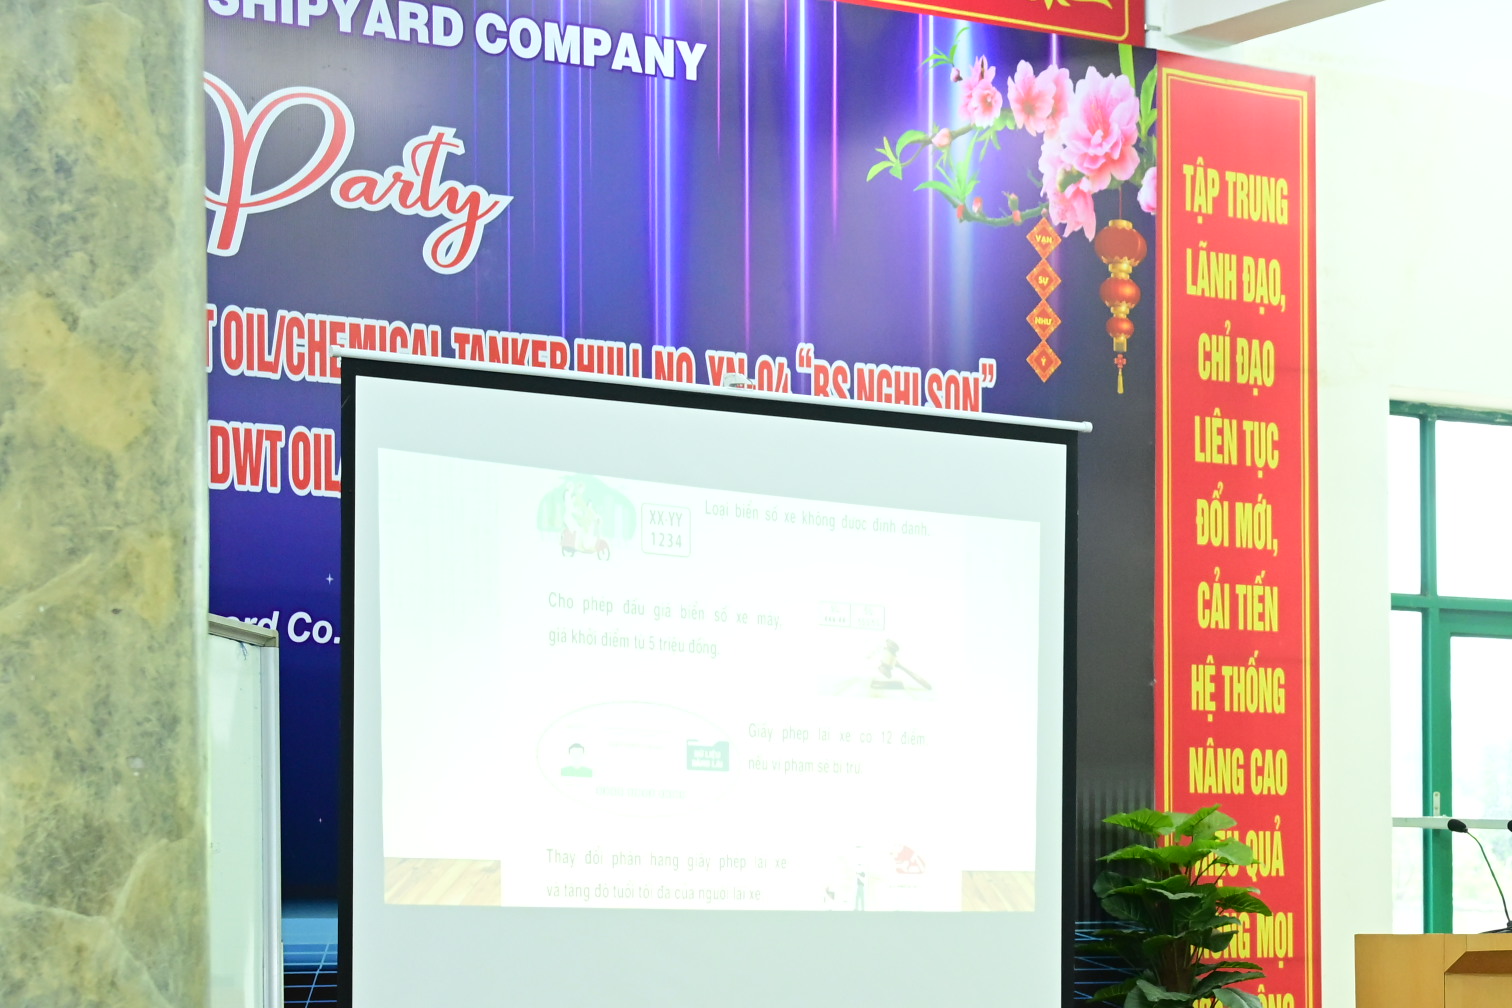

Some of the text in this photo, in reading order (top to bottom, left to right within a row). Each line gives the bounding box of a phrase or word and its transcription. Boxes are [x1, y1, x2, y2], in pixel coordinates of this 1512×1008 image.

[475, 11, 708, 81] COMPANY
[203, 72, 513, 274] Party
[1183, 156, 1288, 225] TẬP TRUNG
[1186, 241, 1286, 315] LÃNH ĐẠO,
[1198, 320, 1275, 396] CHỈ ĐẠO
[289, 426, 341, 498] OIL
[1194, 407, 1279, 478] LIÊN TỤC
[651, 531, 682, 548] 1234
[1196, 481, 1278, 556] ĐỔI MỚI,
[286, 611, 341, 645] Co.
[548, 591, 574, 609] Cho
[1197, 566, 1279, 632] CẢI TIẾN
[1191, 650, 1286, 721] HỆ THỐNG
[882, 730, 892, 744] 12
[1189, 737, 1288, 795] NÂNG CAO
[1246, 815, 1285, 882] QUẢ
[1256, 913, 1293, 968] MỌI
